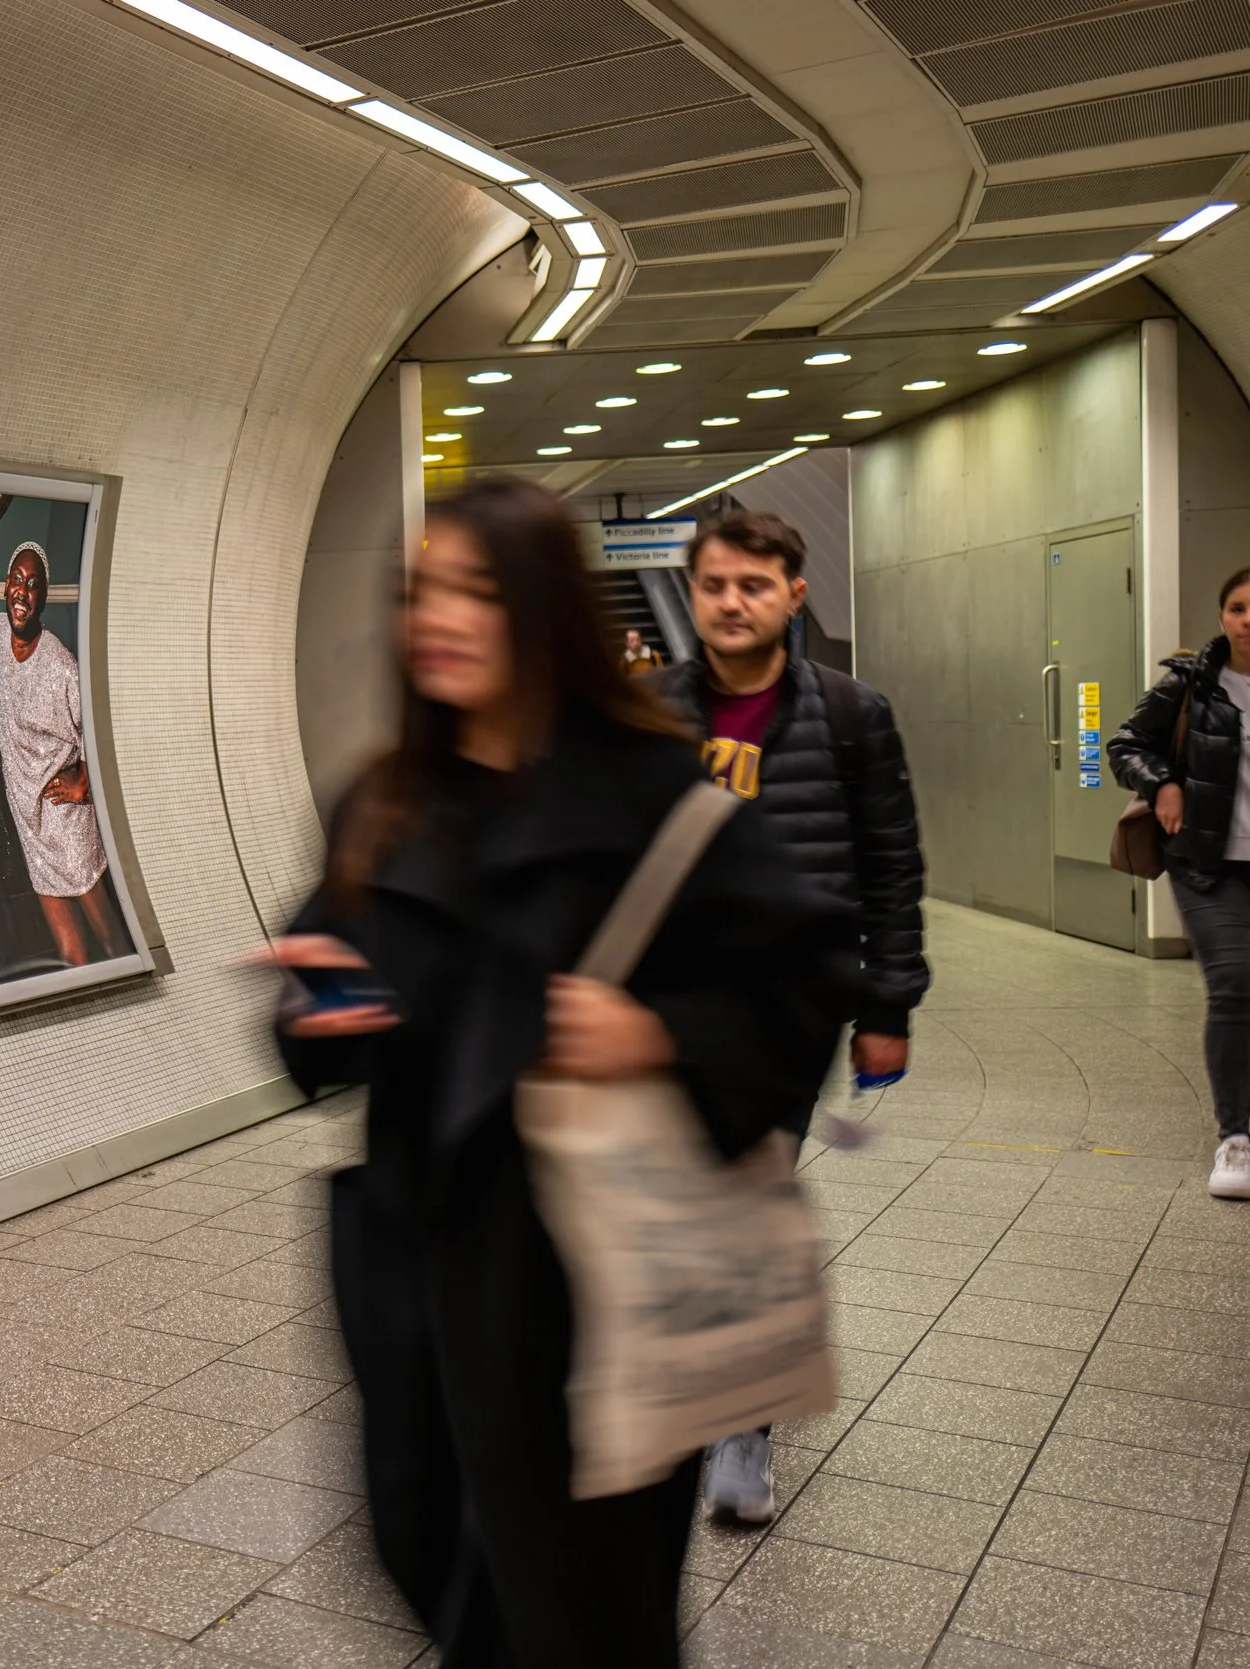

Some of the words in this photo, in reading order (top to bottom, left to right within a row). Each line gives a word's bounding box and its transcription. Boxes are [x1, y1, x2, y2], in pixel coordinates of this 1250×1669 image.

[614, 527, 656, 538] Piccadilly
[658, 526, 675, 535] line
[616, 551, 651, 561] Victoria
[653, 551, 669, 560] line
